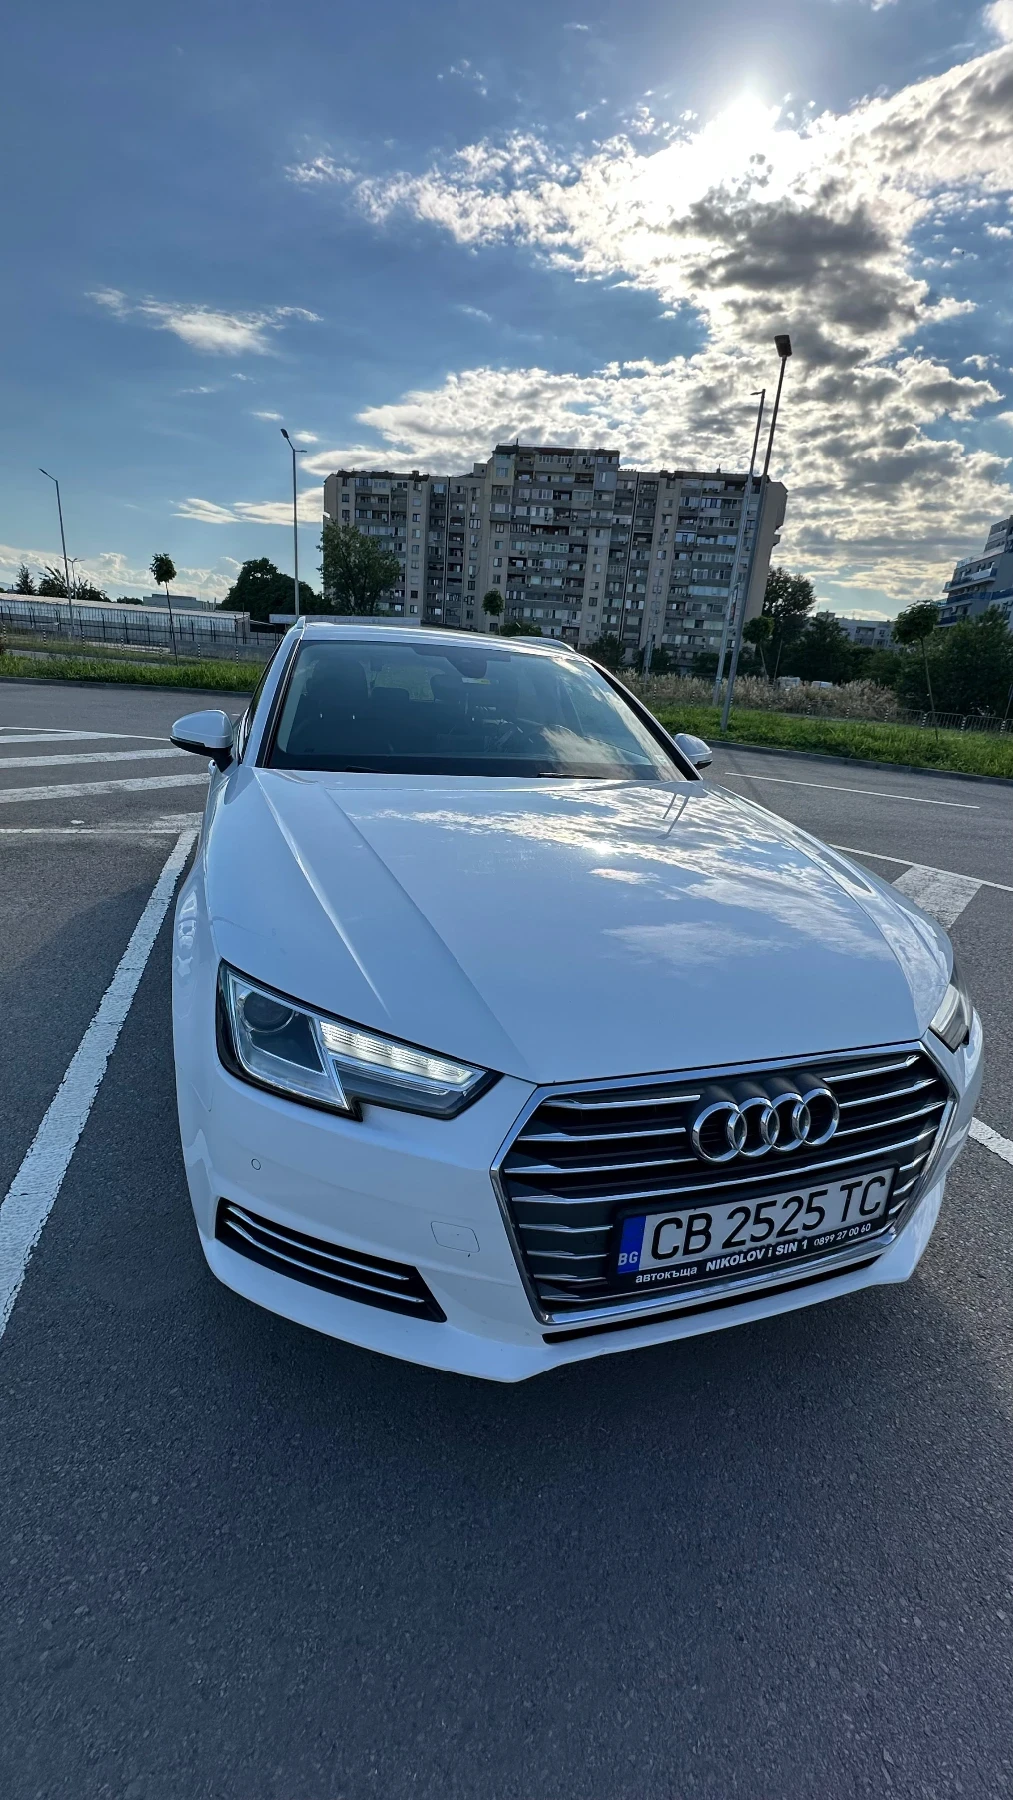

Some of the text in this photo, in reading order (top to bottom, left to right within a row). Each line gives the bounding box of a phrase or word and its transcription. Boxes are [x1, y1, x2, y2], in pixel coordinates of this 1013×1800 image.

[651, 1176, 886, 1260] CB 2525 TC
[618, 1251, 639, 1266] BG
[705, 1248, 765, 1271] NIKOLOV
[775, 1241, 798, 1255] SIN
[802, 1239, 808, 1250] 1
[813, 1234, 835, 1246] 0899
[836, 1230, 847, 1240] 27
[848, 1226, 859, 1237] 00
[860, 1223, 871, 1233] 60
[635, 1266, 698, 1283] автокъща
